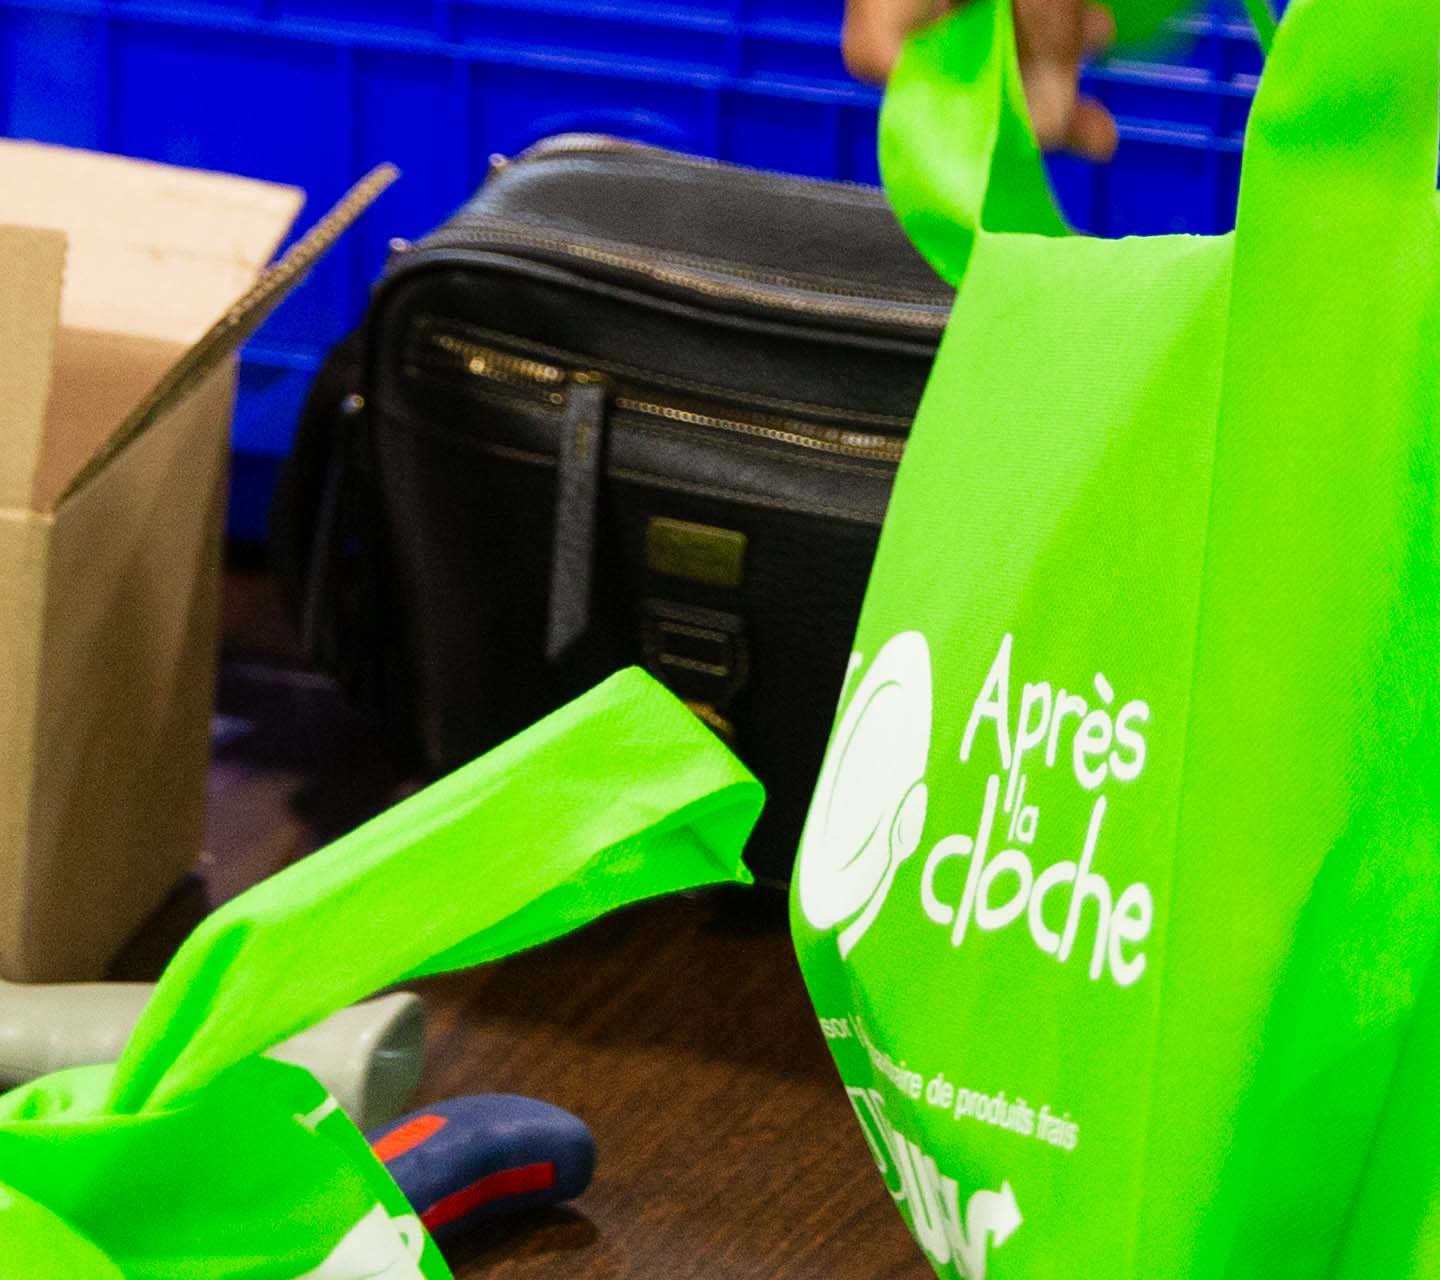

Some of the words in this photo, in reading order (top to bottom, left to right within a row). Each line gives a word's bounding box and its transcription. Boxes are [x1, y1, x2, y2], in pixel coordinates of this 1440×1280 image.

[959, 631, 1151, 813] Après
[1006, 773, 1039, 846] la
[920, 774, 1154, 987] cloche
[927, 1072, 953, 1108] de
[954, 1088, 1034, 1136] produits
[1037, 1104, 1080, 1151] frais
